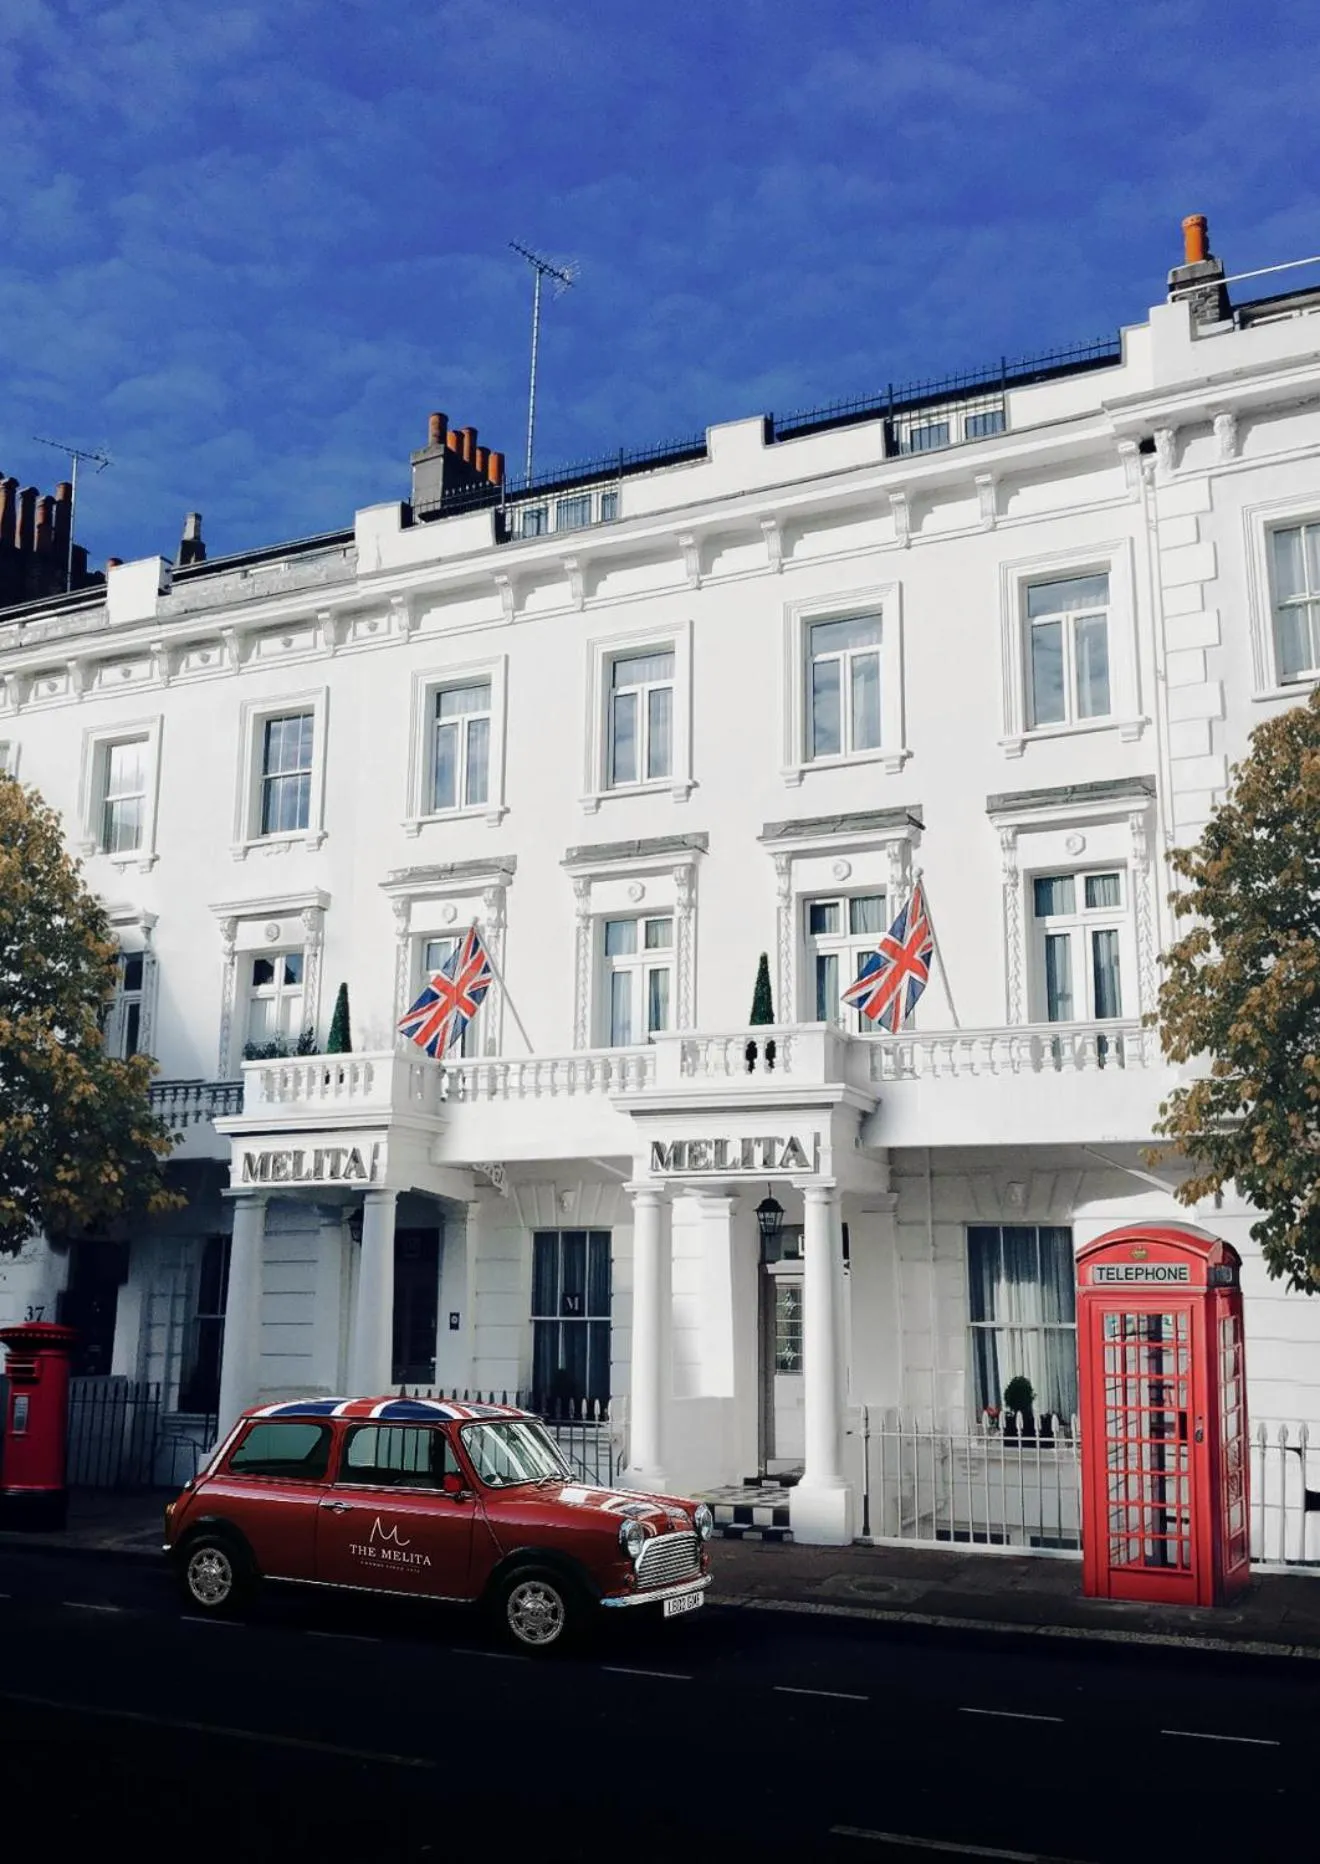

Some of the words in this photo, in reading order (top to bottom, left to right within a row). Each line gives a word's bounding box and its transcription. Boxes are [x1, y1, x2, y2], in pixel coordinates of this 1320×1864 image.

[242, 1147, 369, 1183] MELITA
[651, 1136, 811, 1172] MELITA
[1096, 1266, 1188, 1281] TELEPHONE
[24, 1305, 45, 1322] 37
[349, 1543, 376, 1558] THE
[381, 1548, 431, 1567] MELITA
